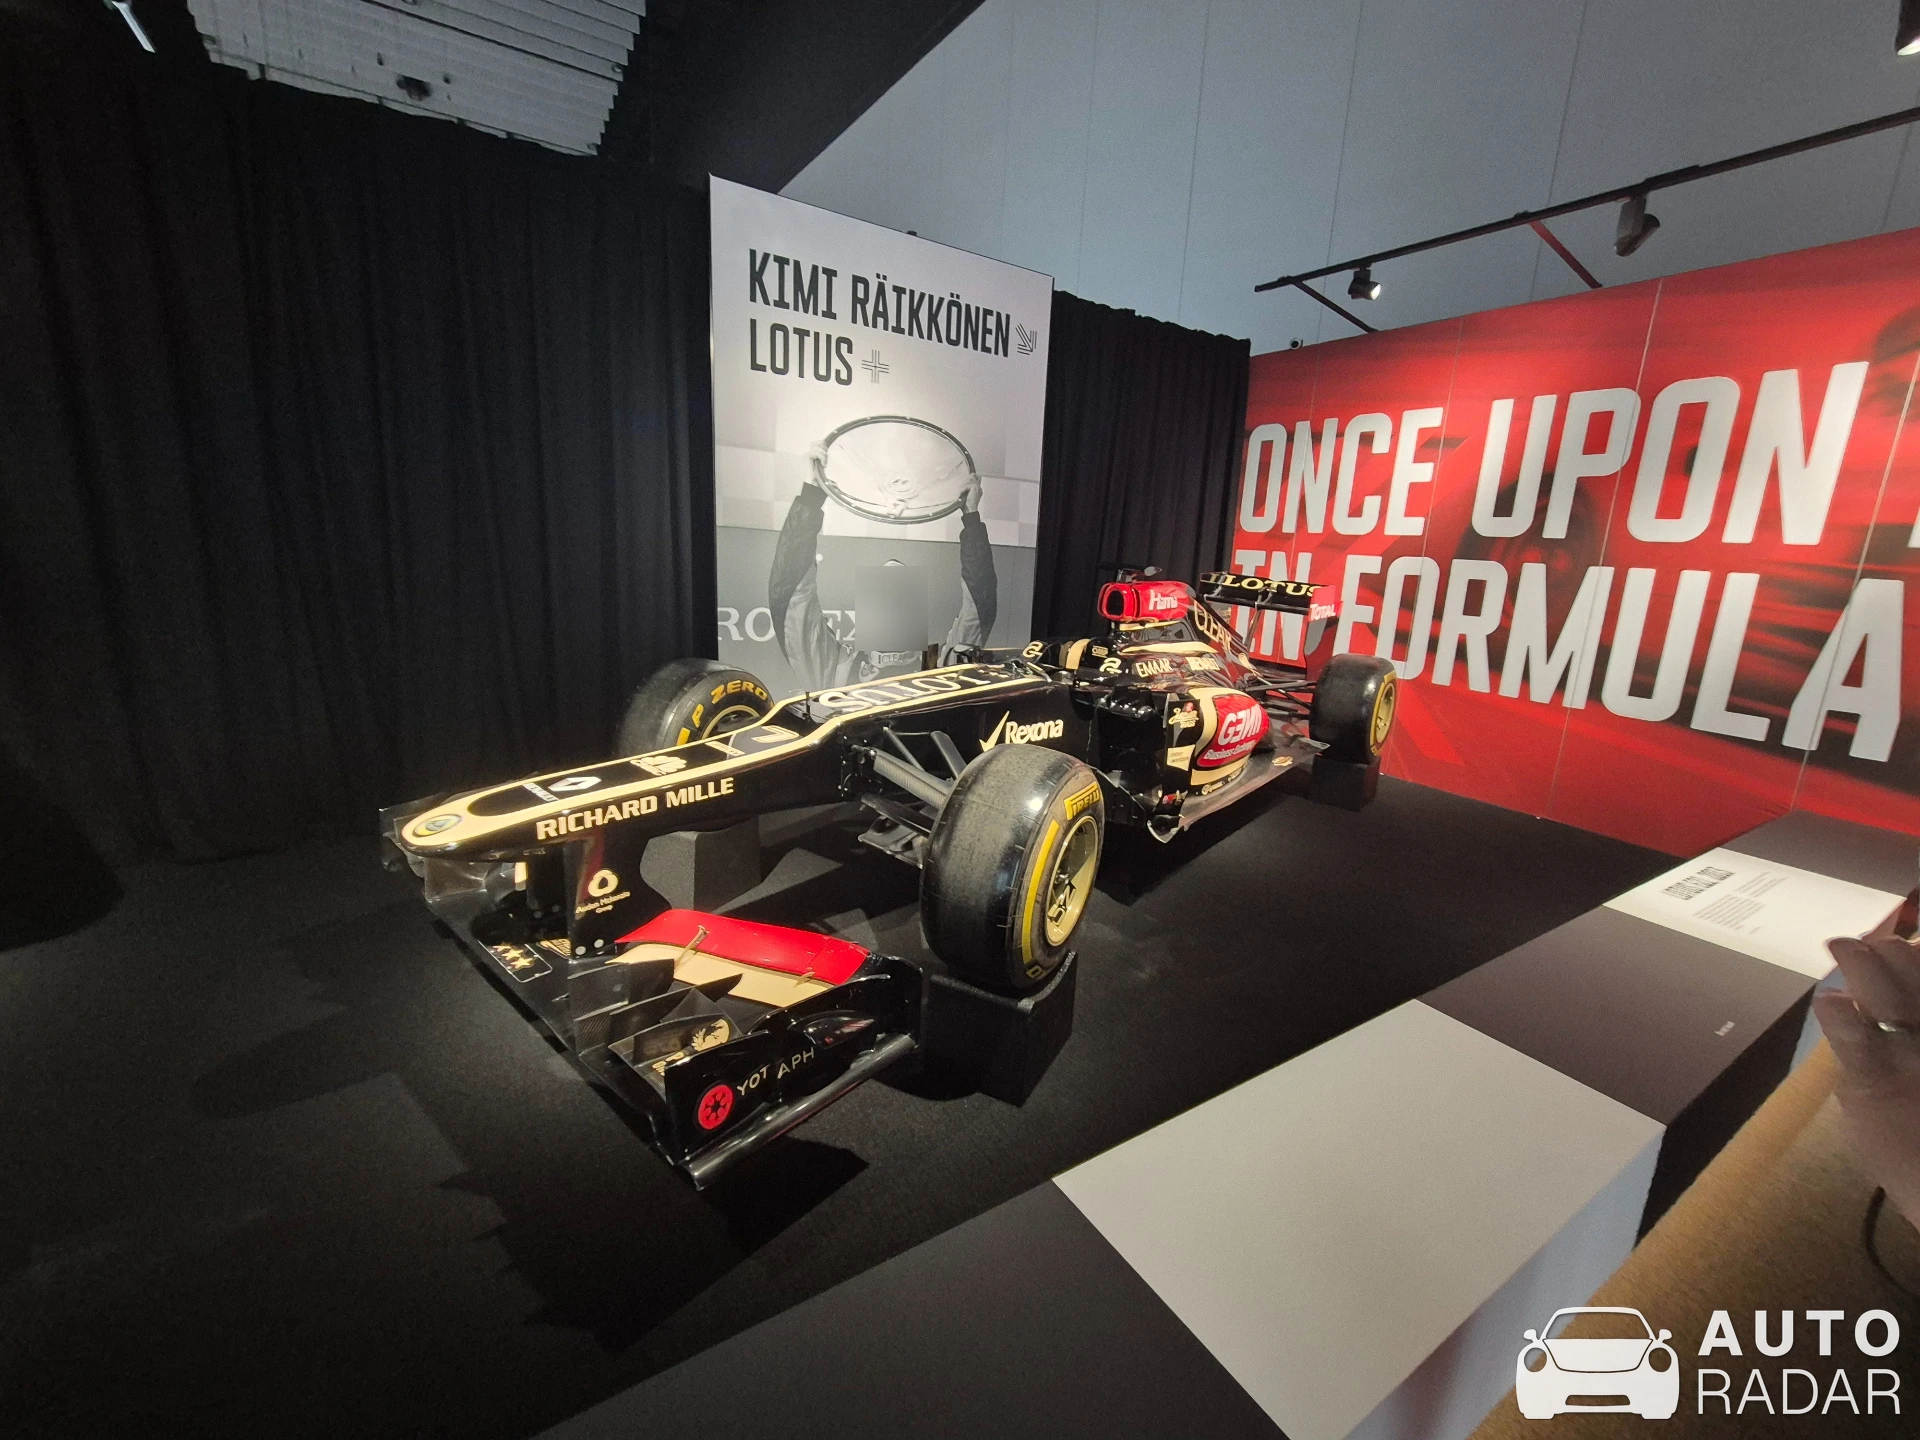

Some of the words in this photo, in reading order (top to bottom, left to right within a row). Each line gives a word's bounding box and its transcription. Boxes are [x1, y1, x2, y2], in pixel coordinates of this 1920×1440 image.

[749, 247, 838, 321] KIMI
[851, 272, 1011, 358] RÄIKKÖNEN
[749, 317, 853, 386] LOTUS
[1239, 406, 1444, 536] ONCE
[1471, 361, 1870, 545] UPON
[1135, 658, 1174, 678] EMAAR
[1232, 549, 1313, 661] IN
[1333, 553, 1905, 763] FORMULA
[710, 679, 769, 705] ZERO
[1005, 718, 1064, 744] Rexona
[536, 795, 658, 840] RICHARD
[665, 777, 734, 808] MILLE
[1064, 780, 1100, 821] PIRELLI
